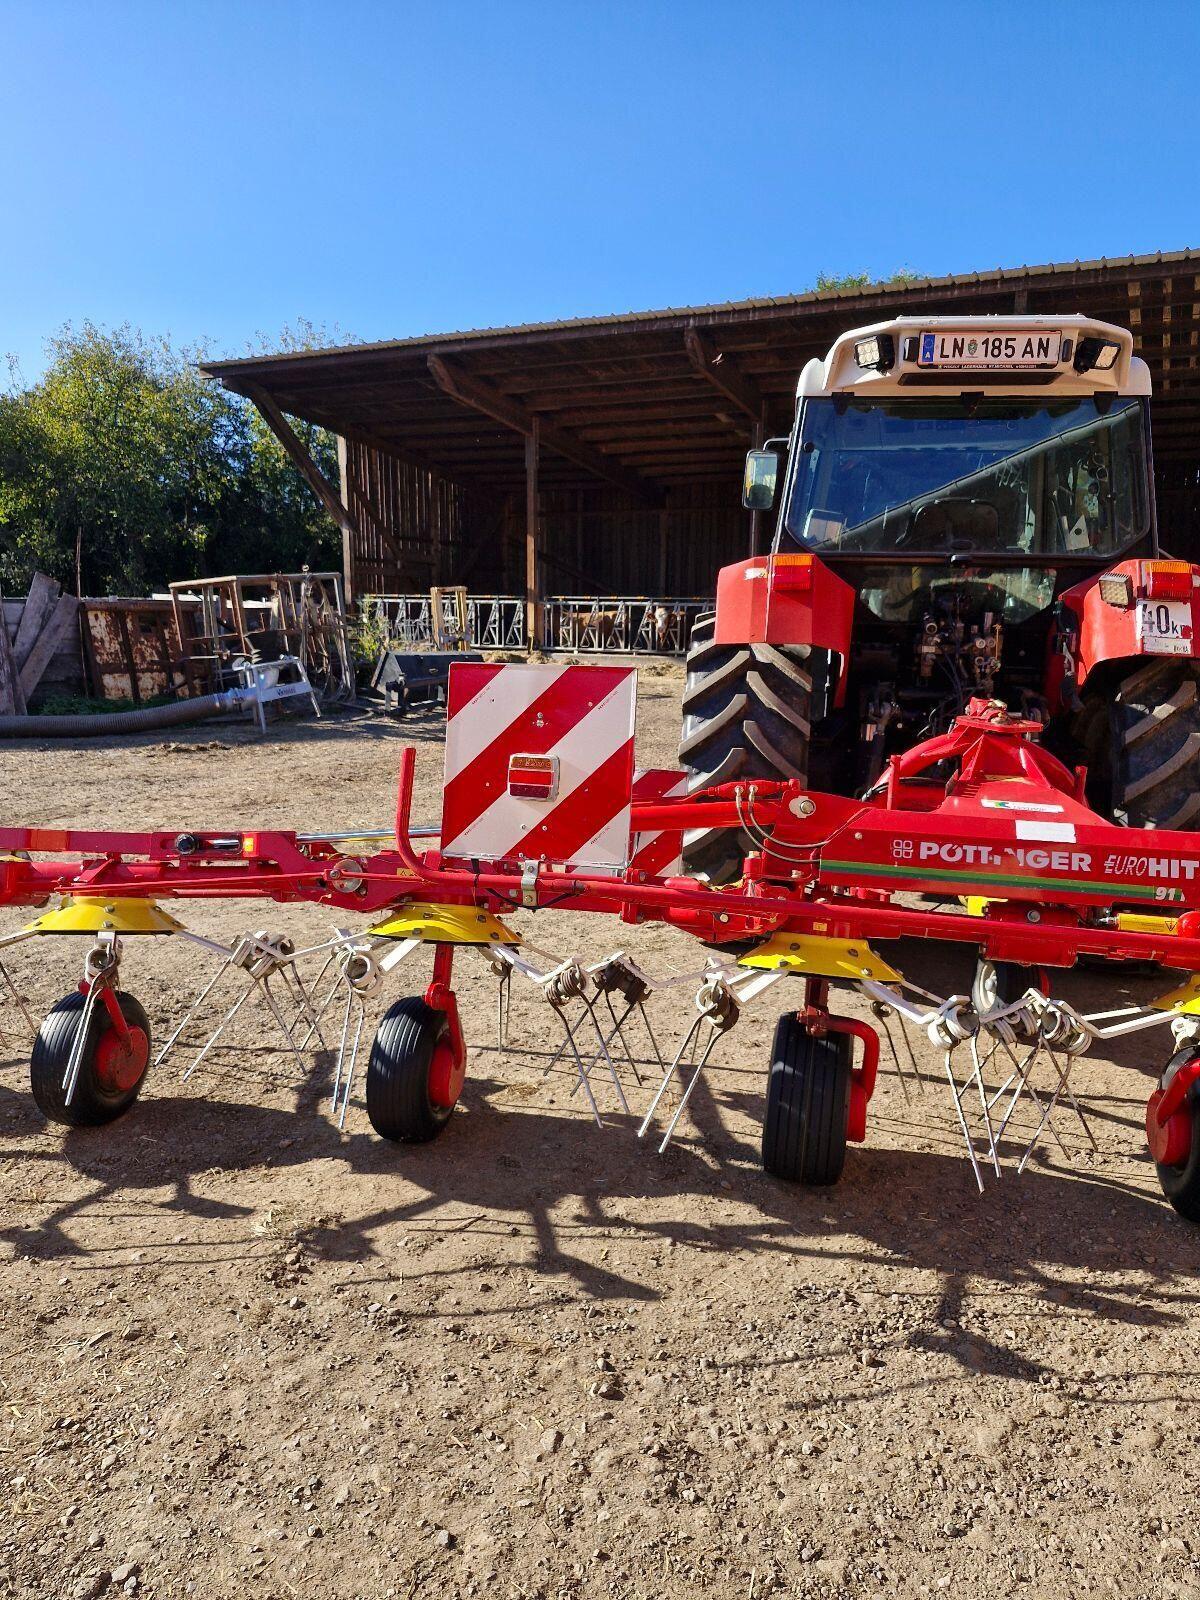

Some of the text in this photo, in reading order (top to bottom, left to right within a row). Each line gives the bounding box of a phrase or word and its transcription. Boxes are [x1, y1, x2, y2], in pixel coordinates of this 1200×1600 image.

[940, 337, 1051, 359] LN 185 AN
